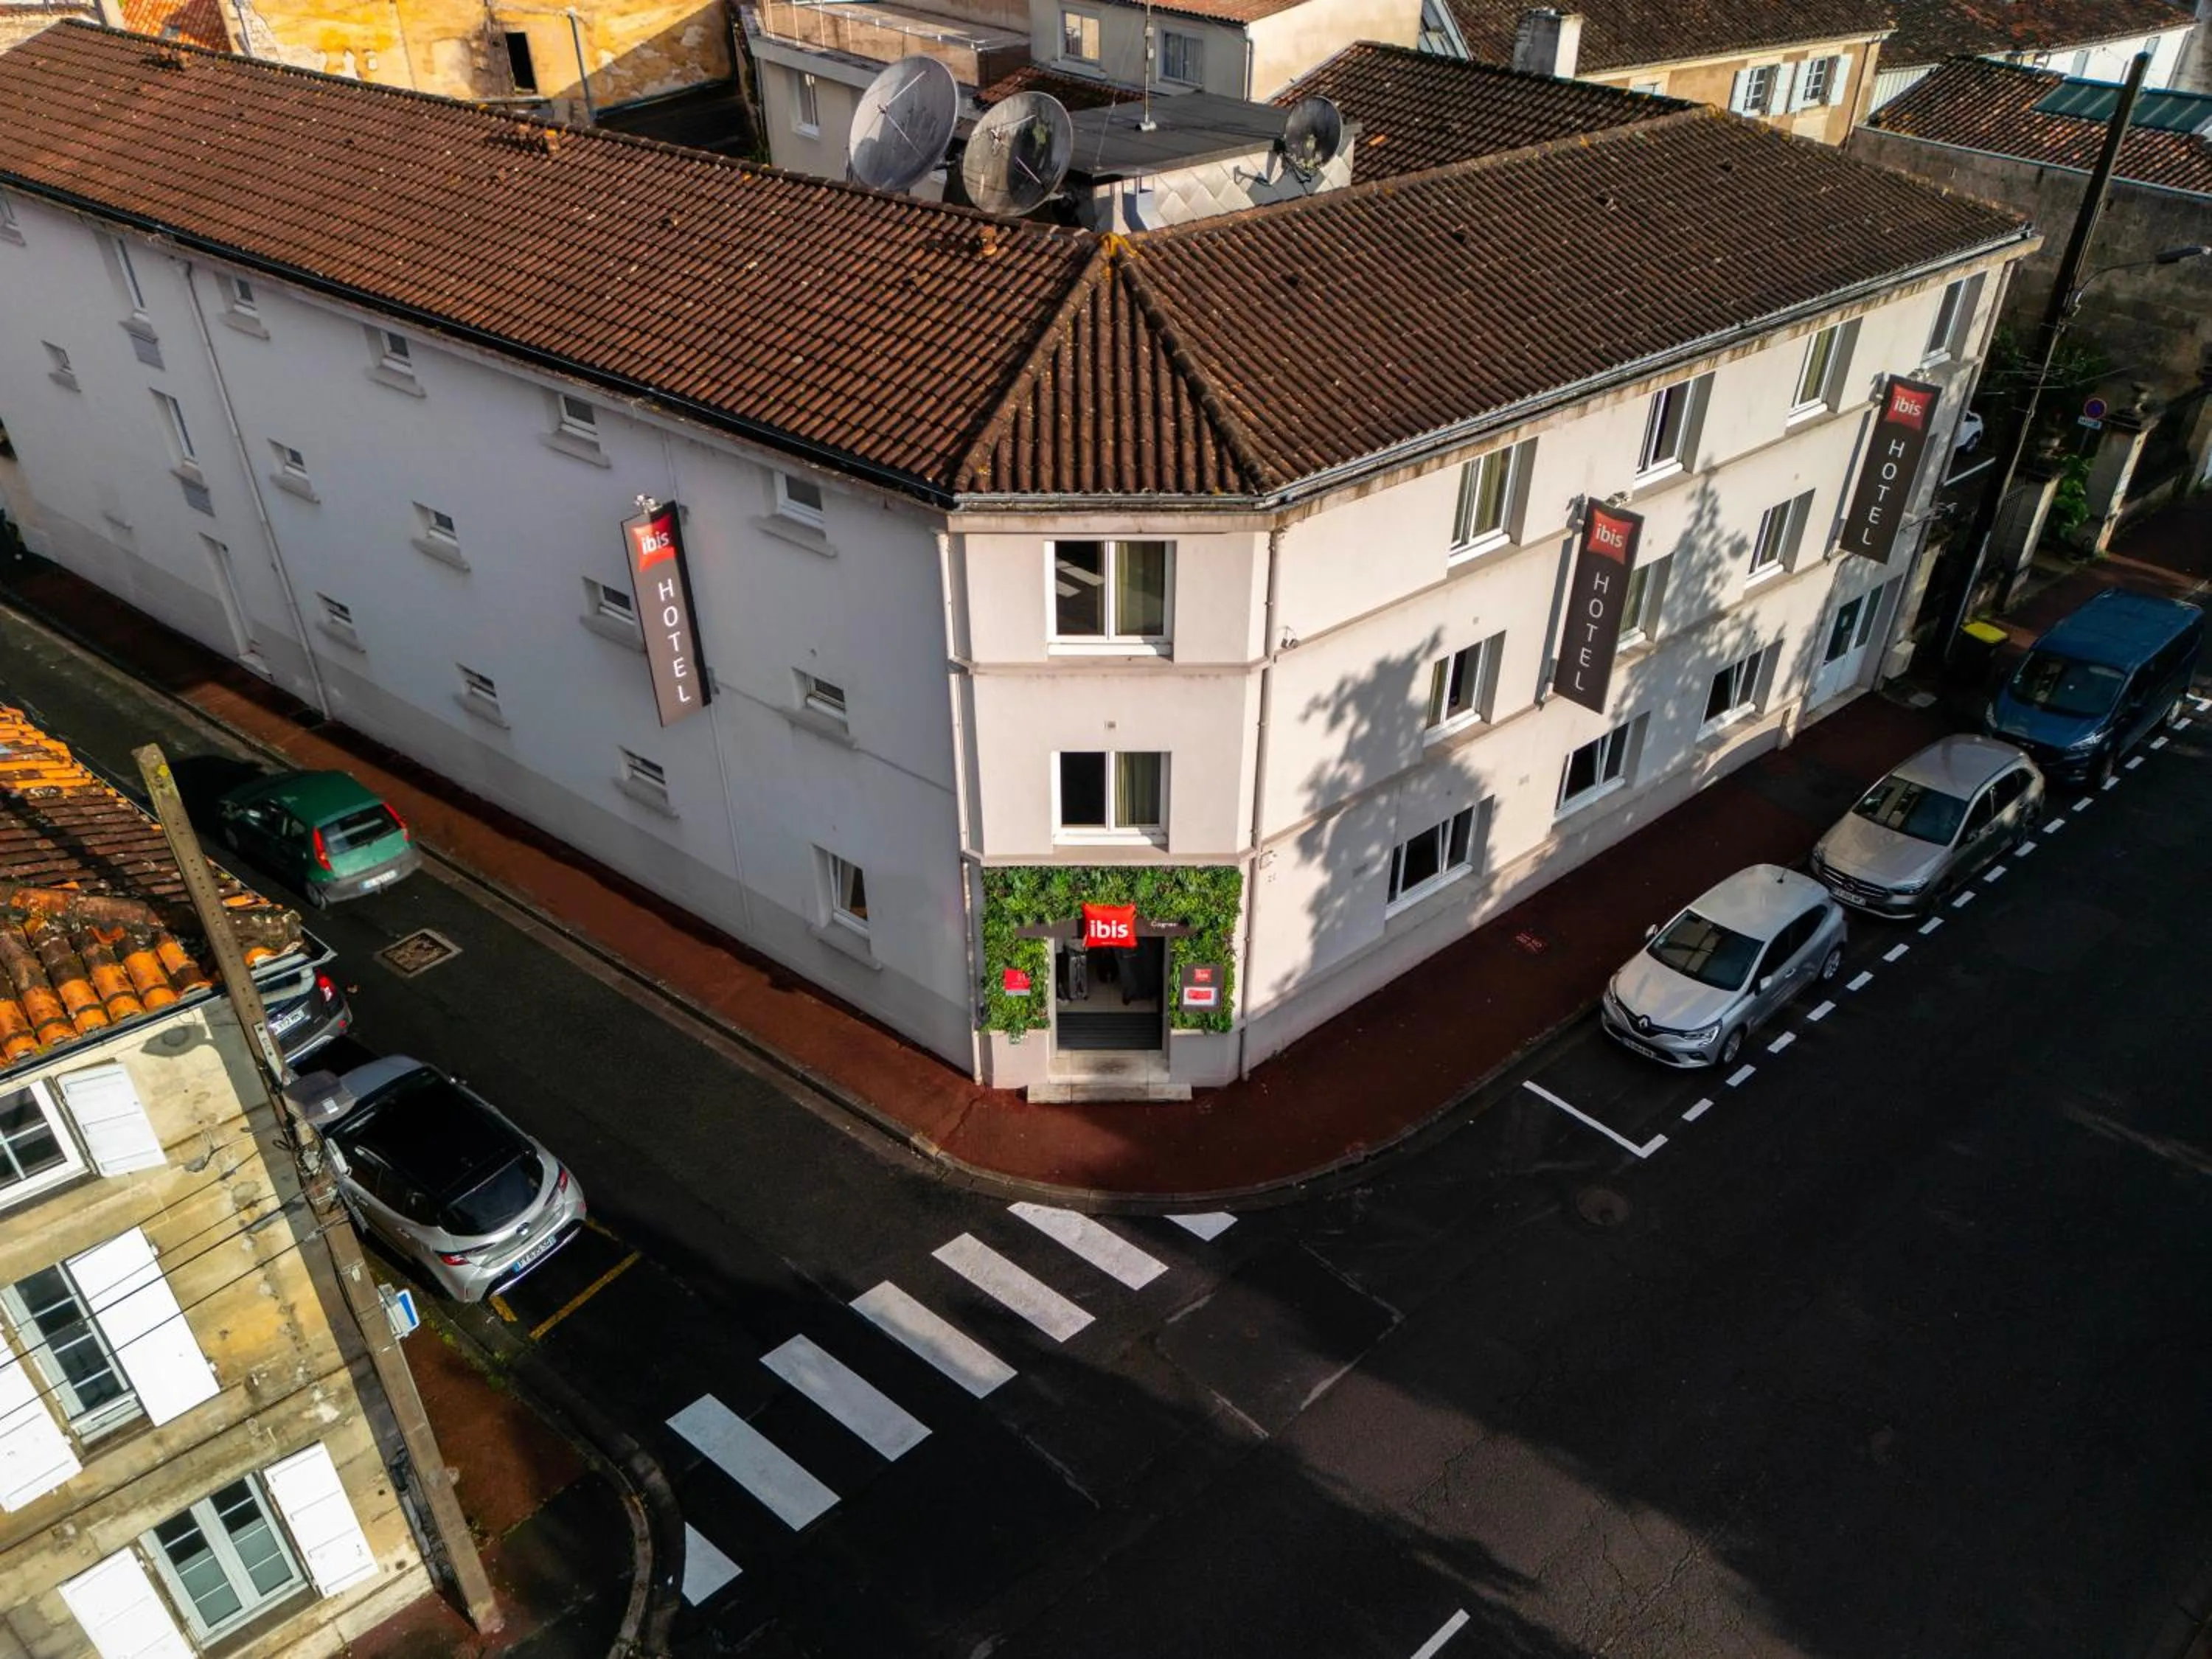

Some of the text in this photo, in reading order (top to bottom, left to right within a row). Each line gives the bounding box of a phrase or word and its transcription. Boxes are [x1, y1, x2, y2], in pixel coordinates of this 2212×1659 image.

[1893, 396, 1921, 417] ibis
[1862, 439, 1905, 545] HOTEL
[641, 532, 669, 555] ibis
[1595, 523, 1624, 549] ibis
[658, 578, 691, 703] HOTEL
[1574, 571, 1610, 692] HOTEL
[1090, 919, 1129, 939] ibis
